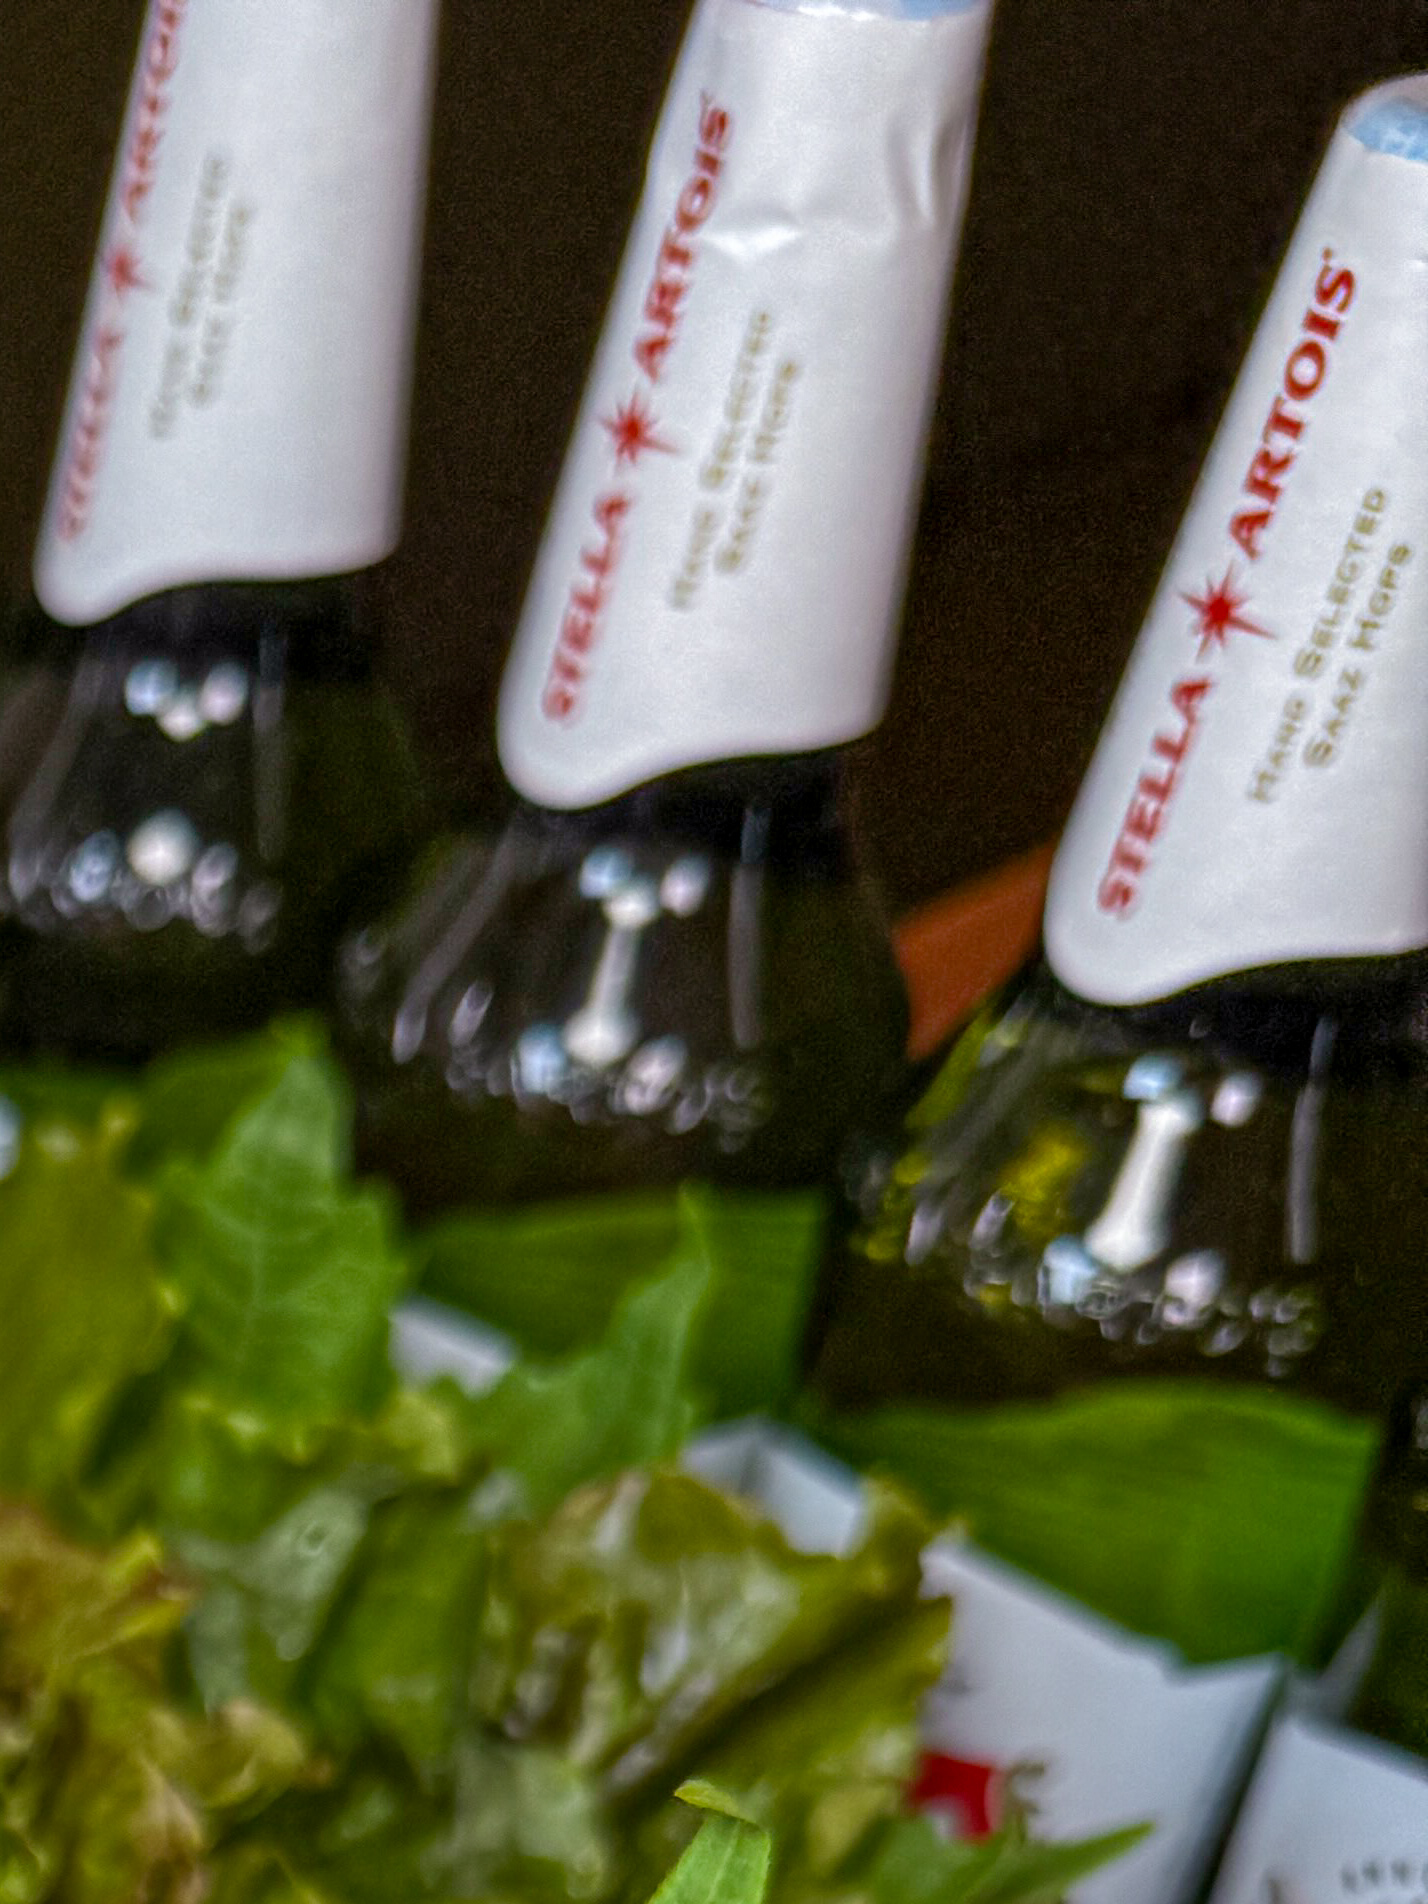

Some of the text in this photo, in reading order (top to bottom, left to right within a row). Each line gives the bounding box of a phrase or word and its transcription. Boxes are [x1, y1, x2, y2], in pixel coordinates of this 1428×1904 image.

[635, 100, 731, 384] ARTOIS
[1094, 250, 1358, 922] STELLA ARTOIS
